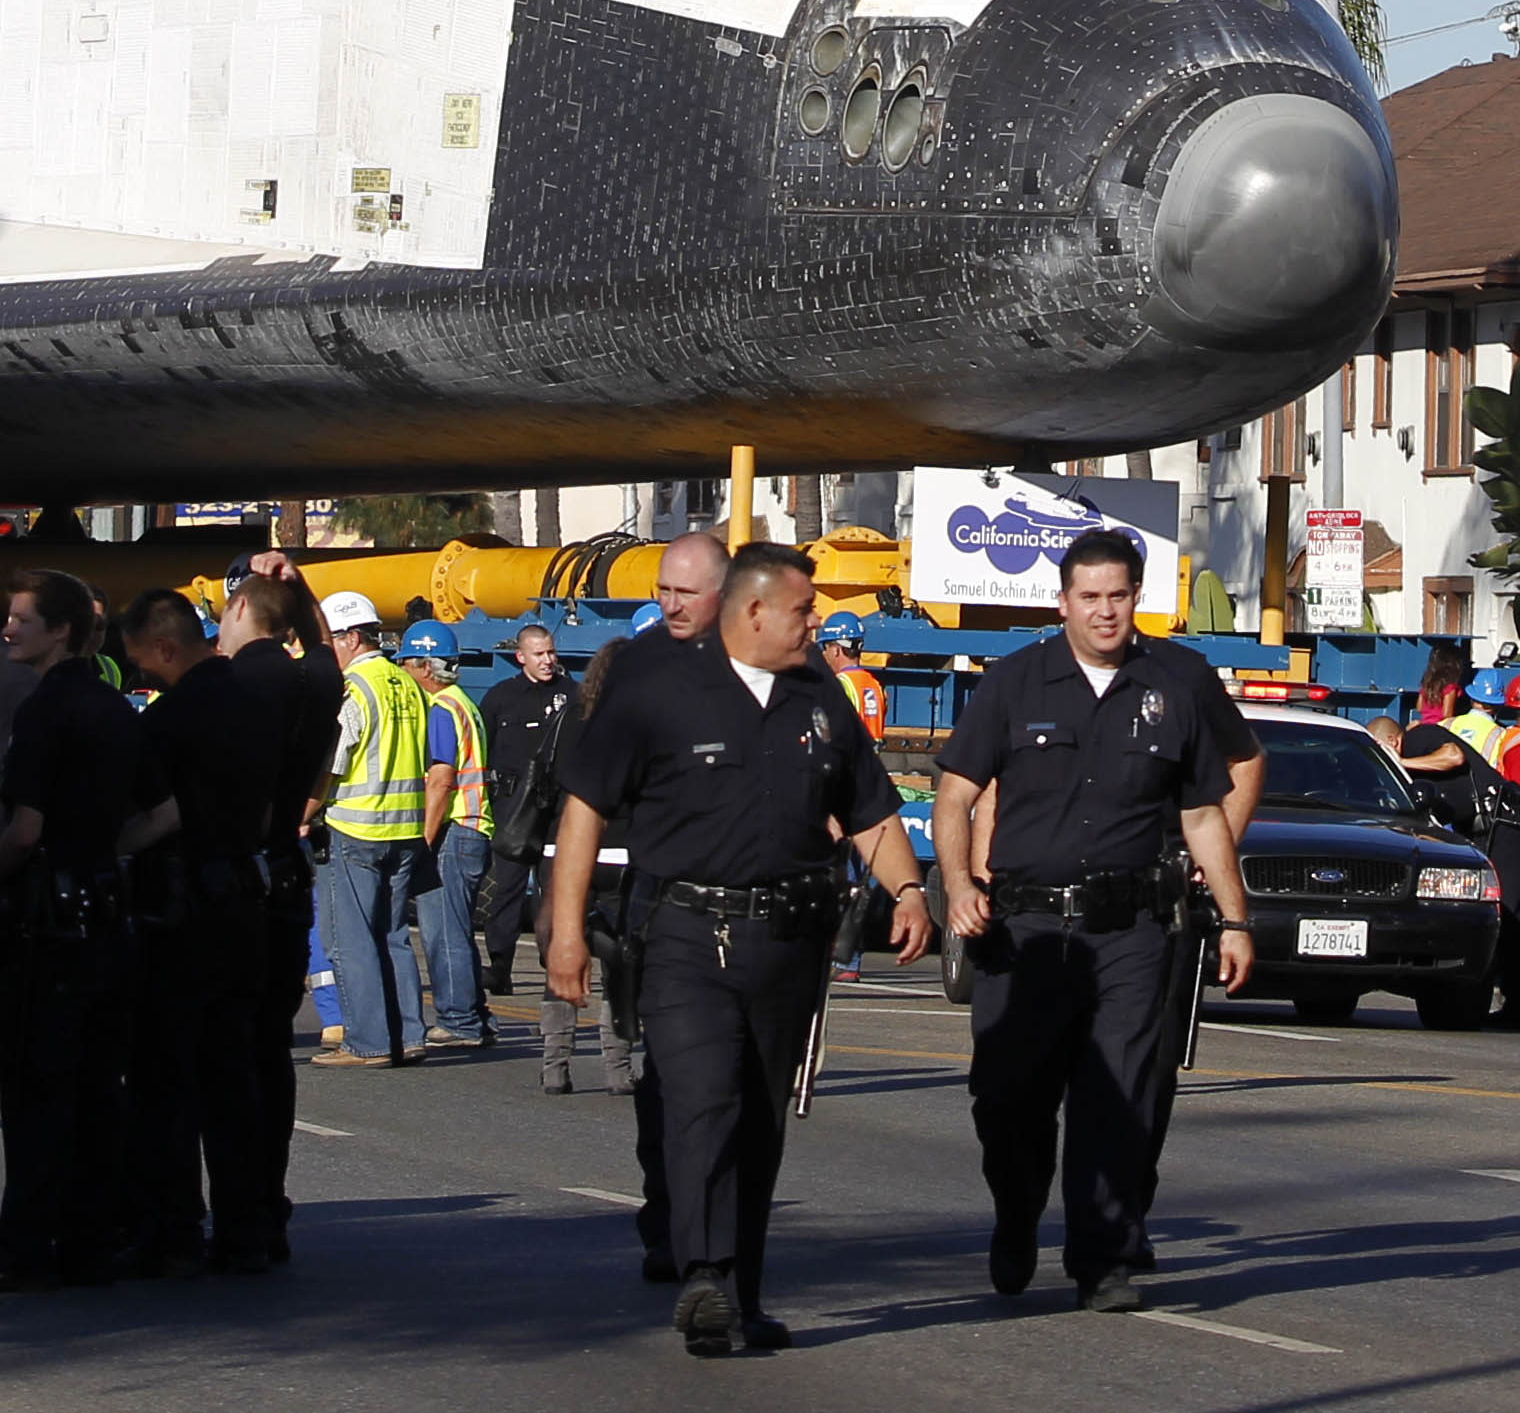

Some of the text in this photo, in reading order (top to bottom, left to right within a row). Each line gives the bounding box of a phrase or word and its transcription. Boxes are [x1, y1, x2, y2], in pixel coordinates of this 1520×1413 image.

[1308, 539, 1324, 554] NO
[943, 579, 986, 597] Samuel
[990, 581, 1027, 599] Oschin
[1030, 583, 1046, 599] Air
[1303, 933, 1361, 951] 1278741
